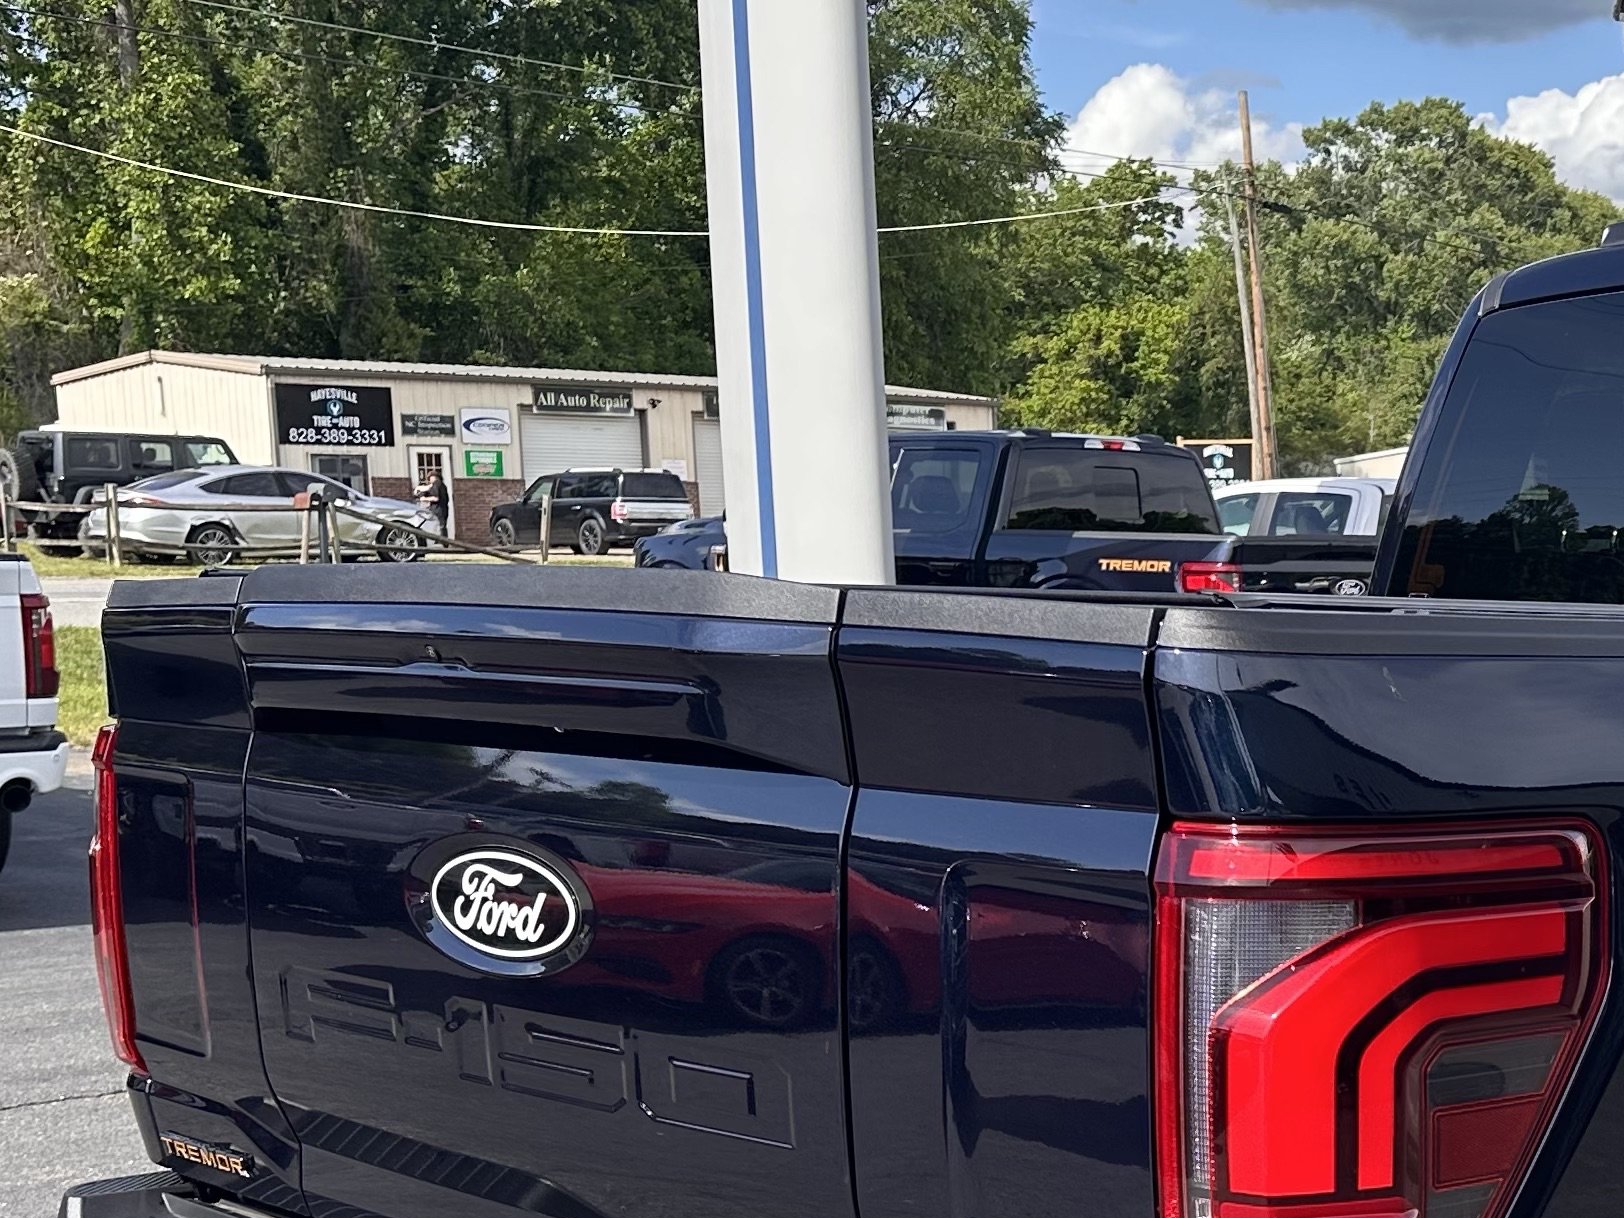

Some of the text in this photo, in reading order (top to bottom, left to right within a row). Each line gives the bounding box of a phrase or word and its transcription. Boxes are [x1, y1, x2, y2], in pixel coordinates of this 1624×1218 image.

[310, 387, 358, 404] HAYESVILLE
[537, 390, 630, 411] All Auto Repair
[288, 427, 386, 444] 828-389-3331
[1098, 558, 1172, 573] TREMOR
[453, 863, 547, 943] Ford
[280, 964, 796, 1150] F-150
[160, 1136, 251, 1178] TREMOR
